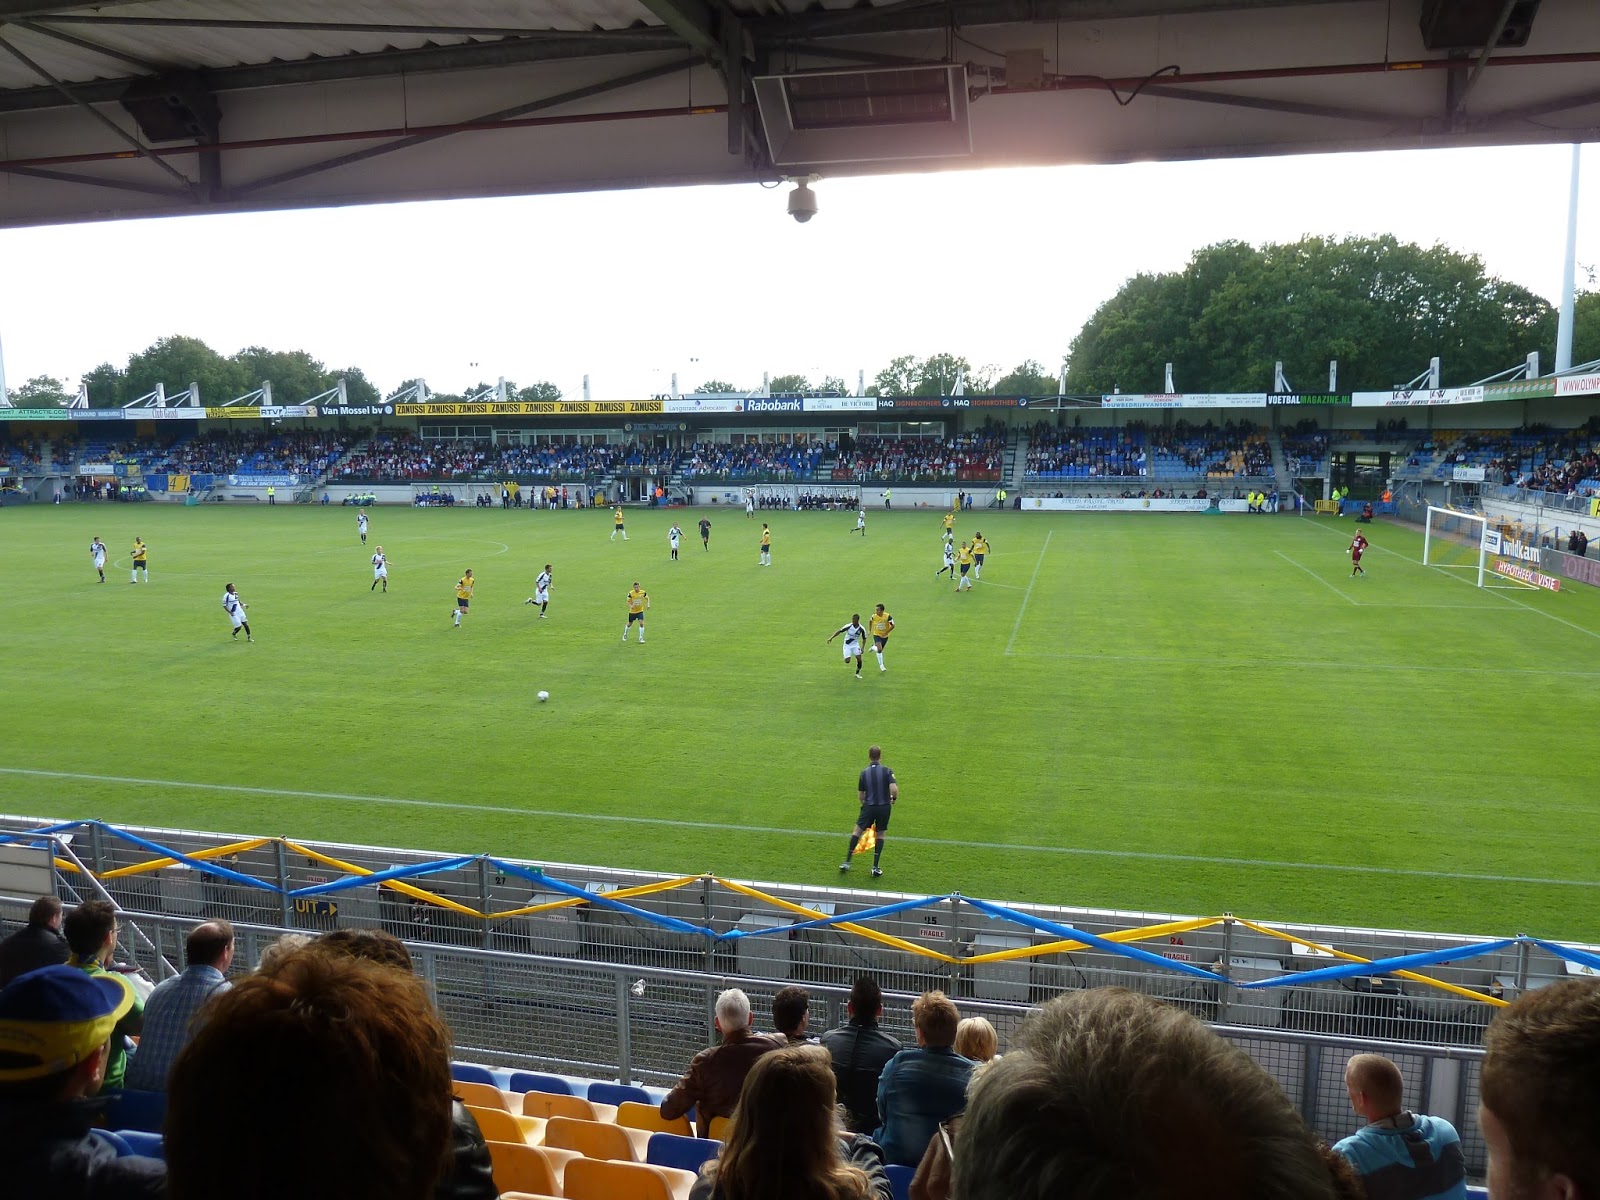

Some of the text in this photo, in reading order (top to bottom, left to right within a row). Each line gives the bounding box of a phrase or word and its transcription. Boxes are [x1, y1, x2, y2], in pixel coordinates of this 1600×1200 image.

[747, 399, 801, 411] Rabobank
[1268, 395, 1351, 405] VOETBALMAGAZINE.NL
[322, 405, 383, 415] Van Mossel bv
[397, 402, 661, 414] ZANUSSI ZANUSSI ZANUSSI ZANUSSI ZANUSSI ZANUSSI ZANUSSI ZANUSSI
[1503, 538, 1542, 563] wildkam
[1498, 561, 1556, 590] HYPOTHEEK VISIE
[495, 876, 506, 885] 27
[295, 899, 319, 915] UIT
[920, 929, 945, 938] FRAGILE
